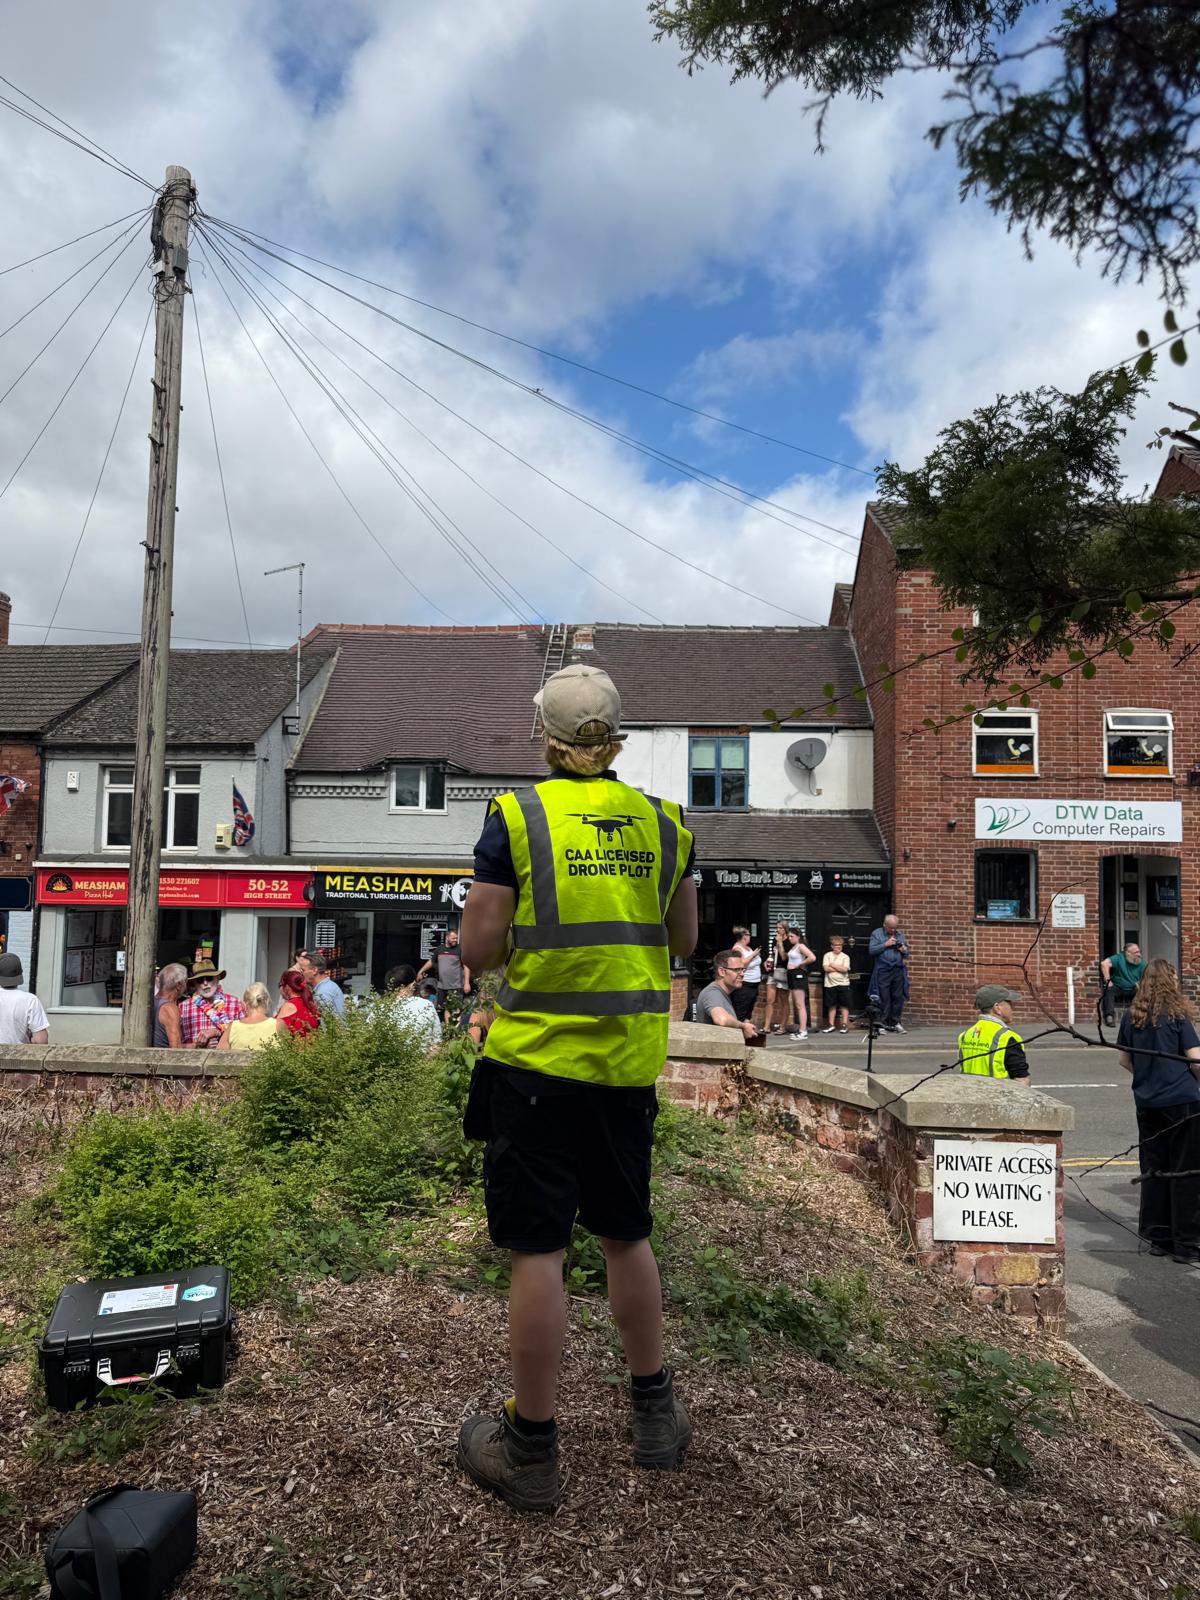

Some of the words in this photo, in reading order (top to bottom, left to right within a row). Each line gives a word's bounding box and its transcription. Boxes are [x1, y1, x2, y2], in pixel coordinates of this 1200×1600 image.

[1056, 805, 1099, 820] DTW
[1104, 806, 1143, 820] Data
[1032, 822, 1105, 837] Computer
[1109, 823, 1166, 837] Repairs
[565, 849, 593, 861] CAA
[595, 849, 655, 863] LICENSED
[568, 864, 616, 877] DRONE
[715, 870, 739, 883] The
[741, 870, 771, 884] Bark
[772, 870, 798, 884] Box
[74, 881, 126, 890] MEASHAM
[248, 879, 289, 892] 50-52
[325, 875, 433, 893] MEASHAM
[84, 890, 101, 898] Pizza
[102, 890, 114, 899] Hub
[325, 891, 369, 899] TRADITONAL
[400, 893, 432, 901] BARBERS
[936, 1155, 993, 1172] PRIVATE
[998, 1157, 1053, 1174] ACCESS
[943, 1181, 969, 1199] NO
[975, 1182, 1042, 1201] WAITING
[962, 1210, 1018, 1228] PLEASE.
